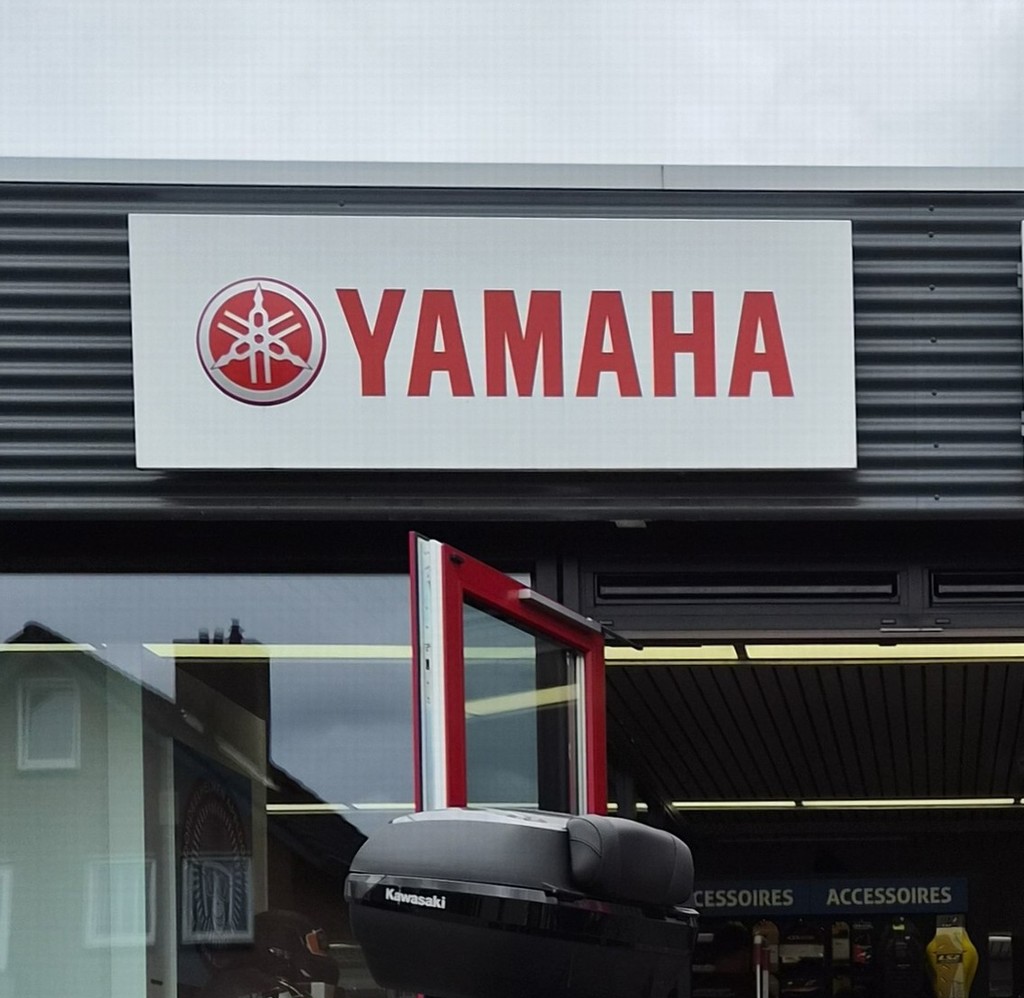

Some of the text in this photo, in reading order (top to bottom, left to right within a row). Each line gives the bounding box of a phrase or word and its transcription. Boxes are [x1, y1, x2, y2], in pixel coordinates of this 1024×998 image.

[336, 288, 795, 398] YAMAHA
[385, 887, 446, 909] Kawasaki
[693, 888, 795, 908] CESSOIRES
[826, 886, 953, 906] ACCESSOIRES
